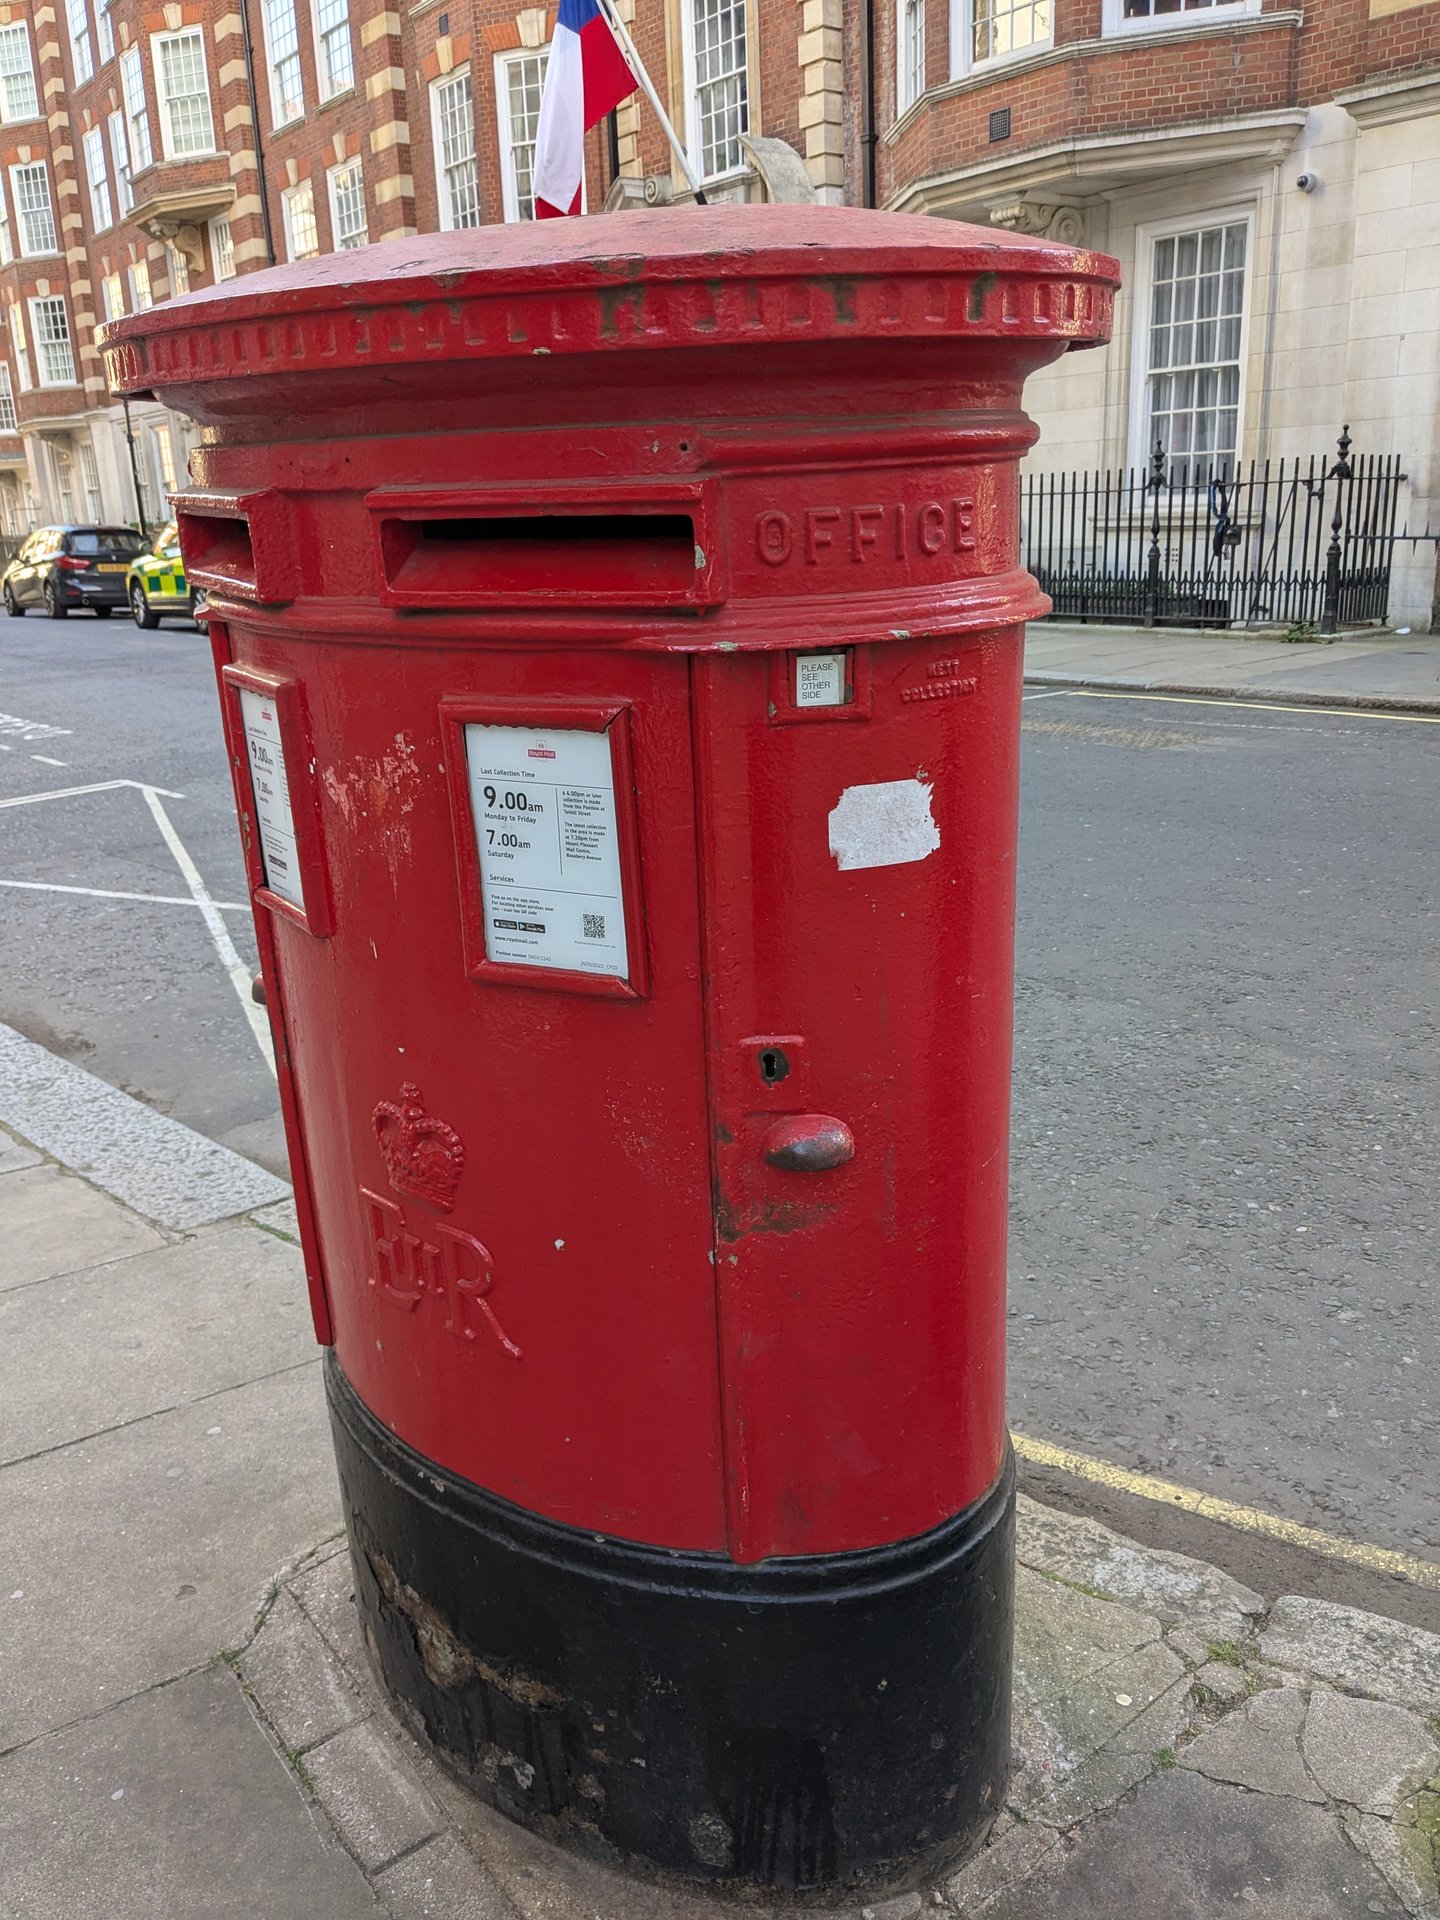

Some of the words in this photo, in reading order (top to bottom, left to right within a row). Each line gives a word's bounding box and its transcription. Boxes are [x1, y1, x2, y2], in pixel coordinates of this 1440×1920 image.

[756, 497, 976, 567] OFFICE
[801, 663, 833, 672] PLEASE
[801, 673, 818, 681] SEE
[801, 681, 830, 690] OTHER
[802, 691, 821, 699] SIDE
[480, 767, 493, 775] Last
[494, 769, 520, 777] Collection
[483, 785, 544, 812] 9.00am
[485, 812, 508, 821] Monday
[509, 814, 516, 822] to
[518, 815, 536, 825] Friday
[486, 829, 531, 849] 7.00am
[487, 849, 515, 860] Saturday
[489, 873, 515, 883] Services
[495, 935, 539, 945] www.royalmail.com
